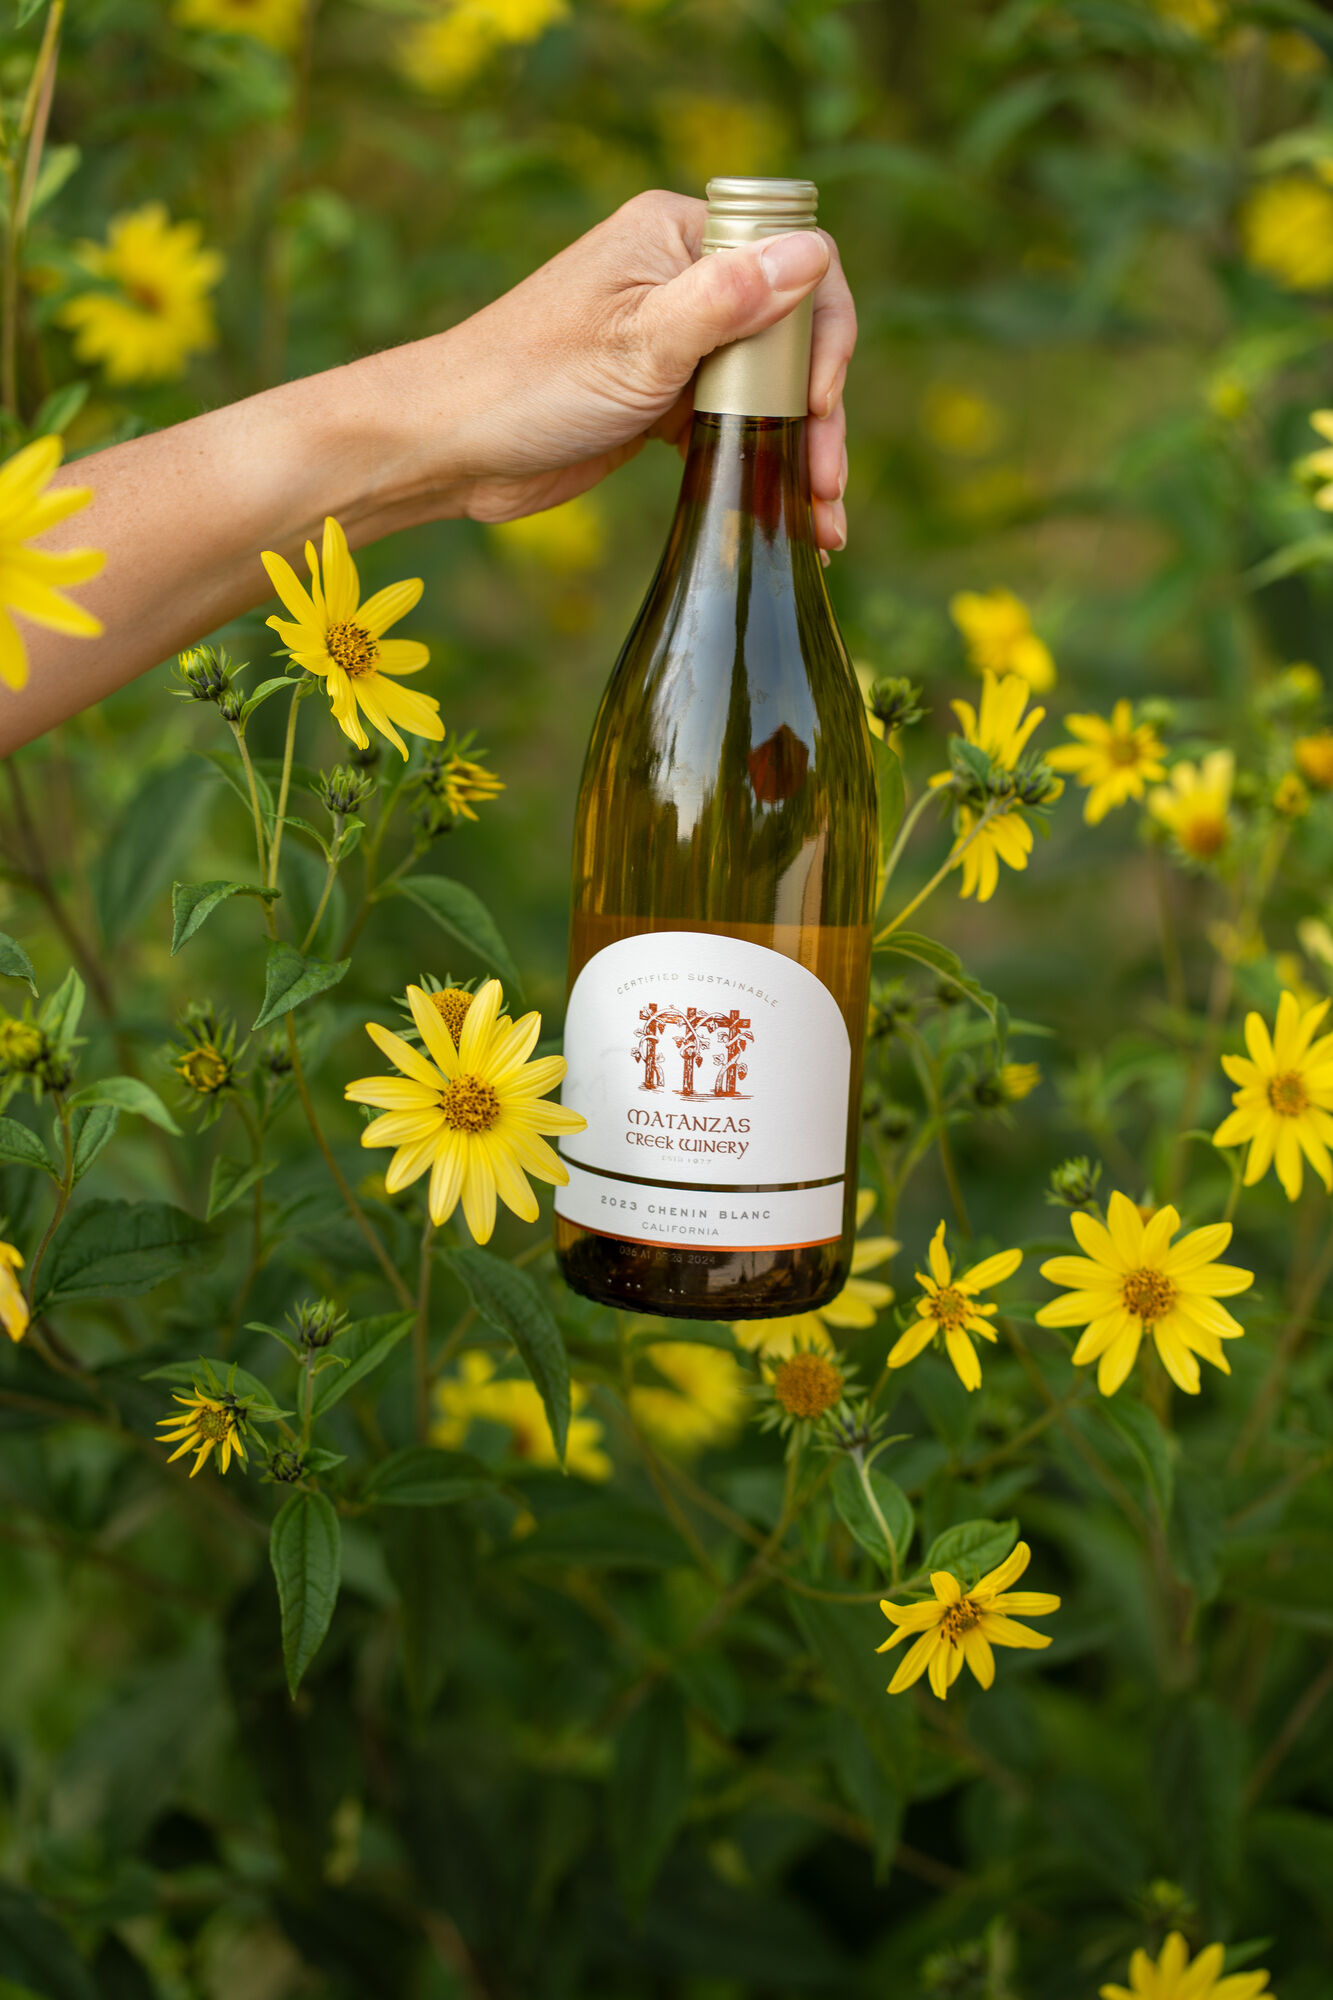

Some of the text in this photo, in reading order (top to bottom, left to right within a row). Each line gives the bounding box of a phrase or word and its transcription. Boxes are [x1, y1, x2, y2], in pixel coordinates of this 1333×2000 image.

[616, 973, 779, 1008] CERTIFIED SUSTAINABLE
[627, 1108, 751, 1133] MATANZAS
[626, 1131, 750, 1160] CREEK WINERY
[600, 1195, 771, 1220] 2023 CHENIN BLANC
[641, 1221, 720, 1237] CALIFORNIA
[687, 1254, 716, 1265] 2024
